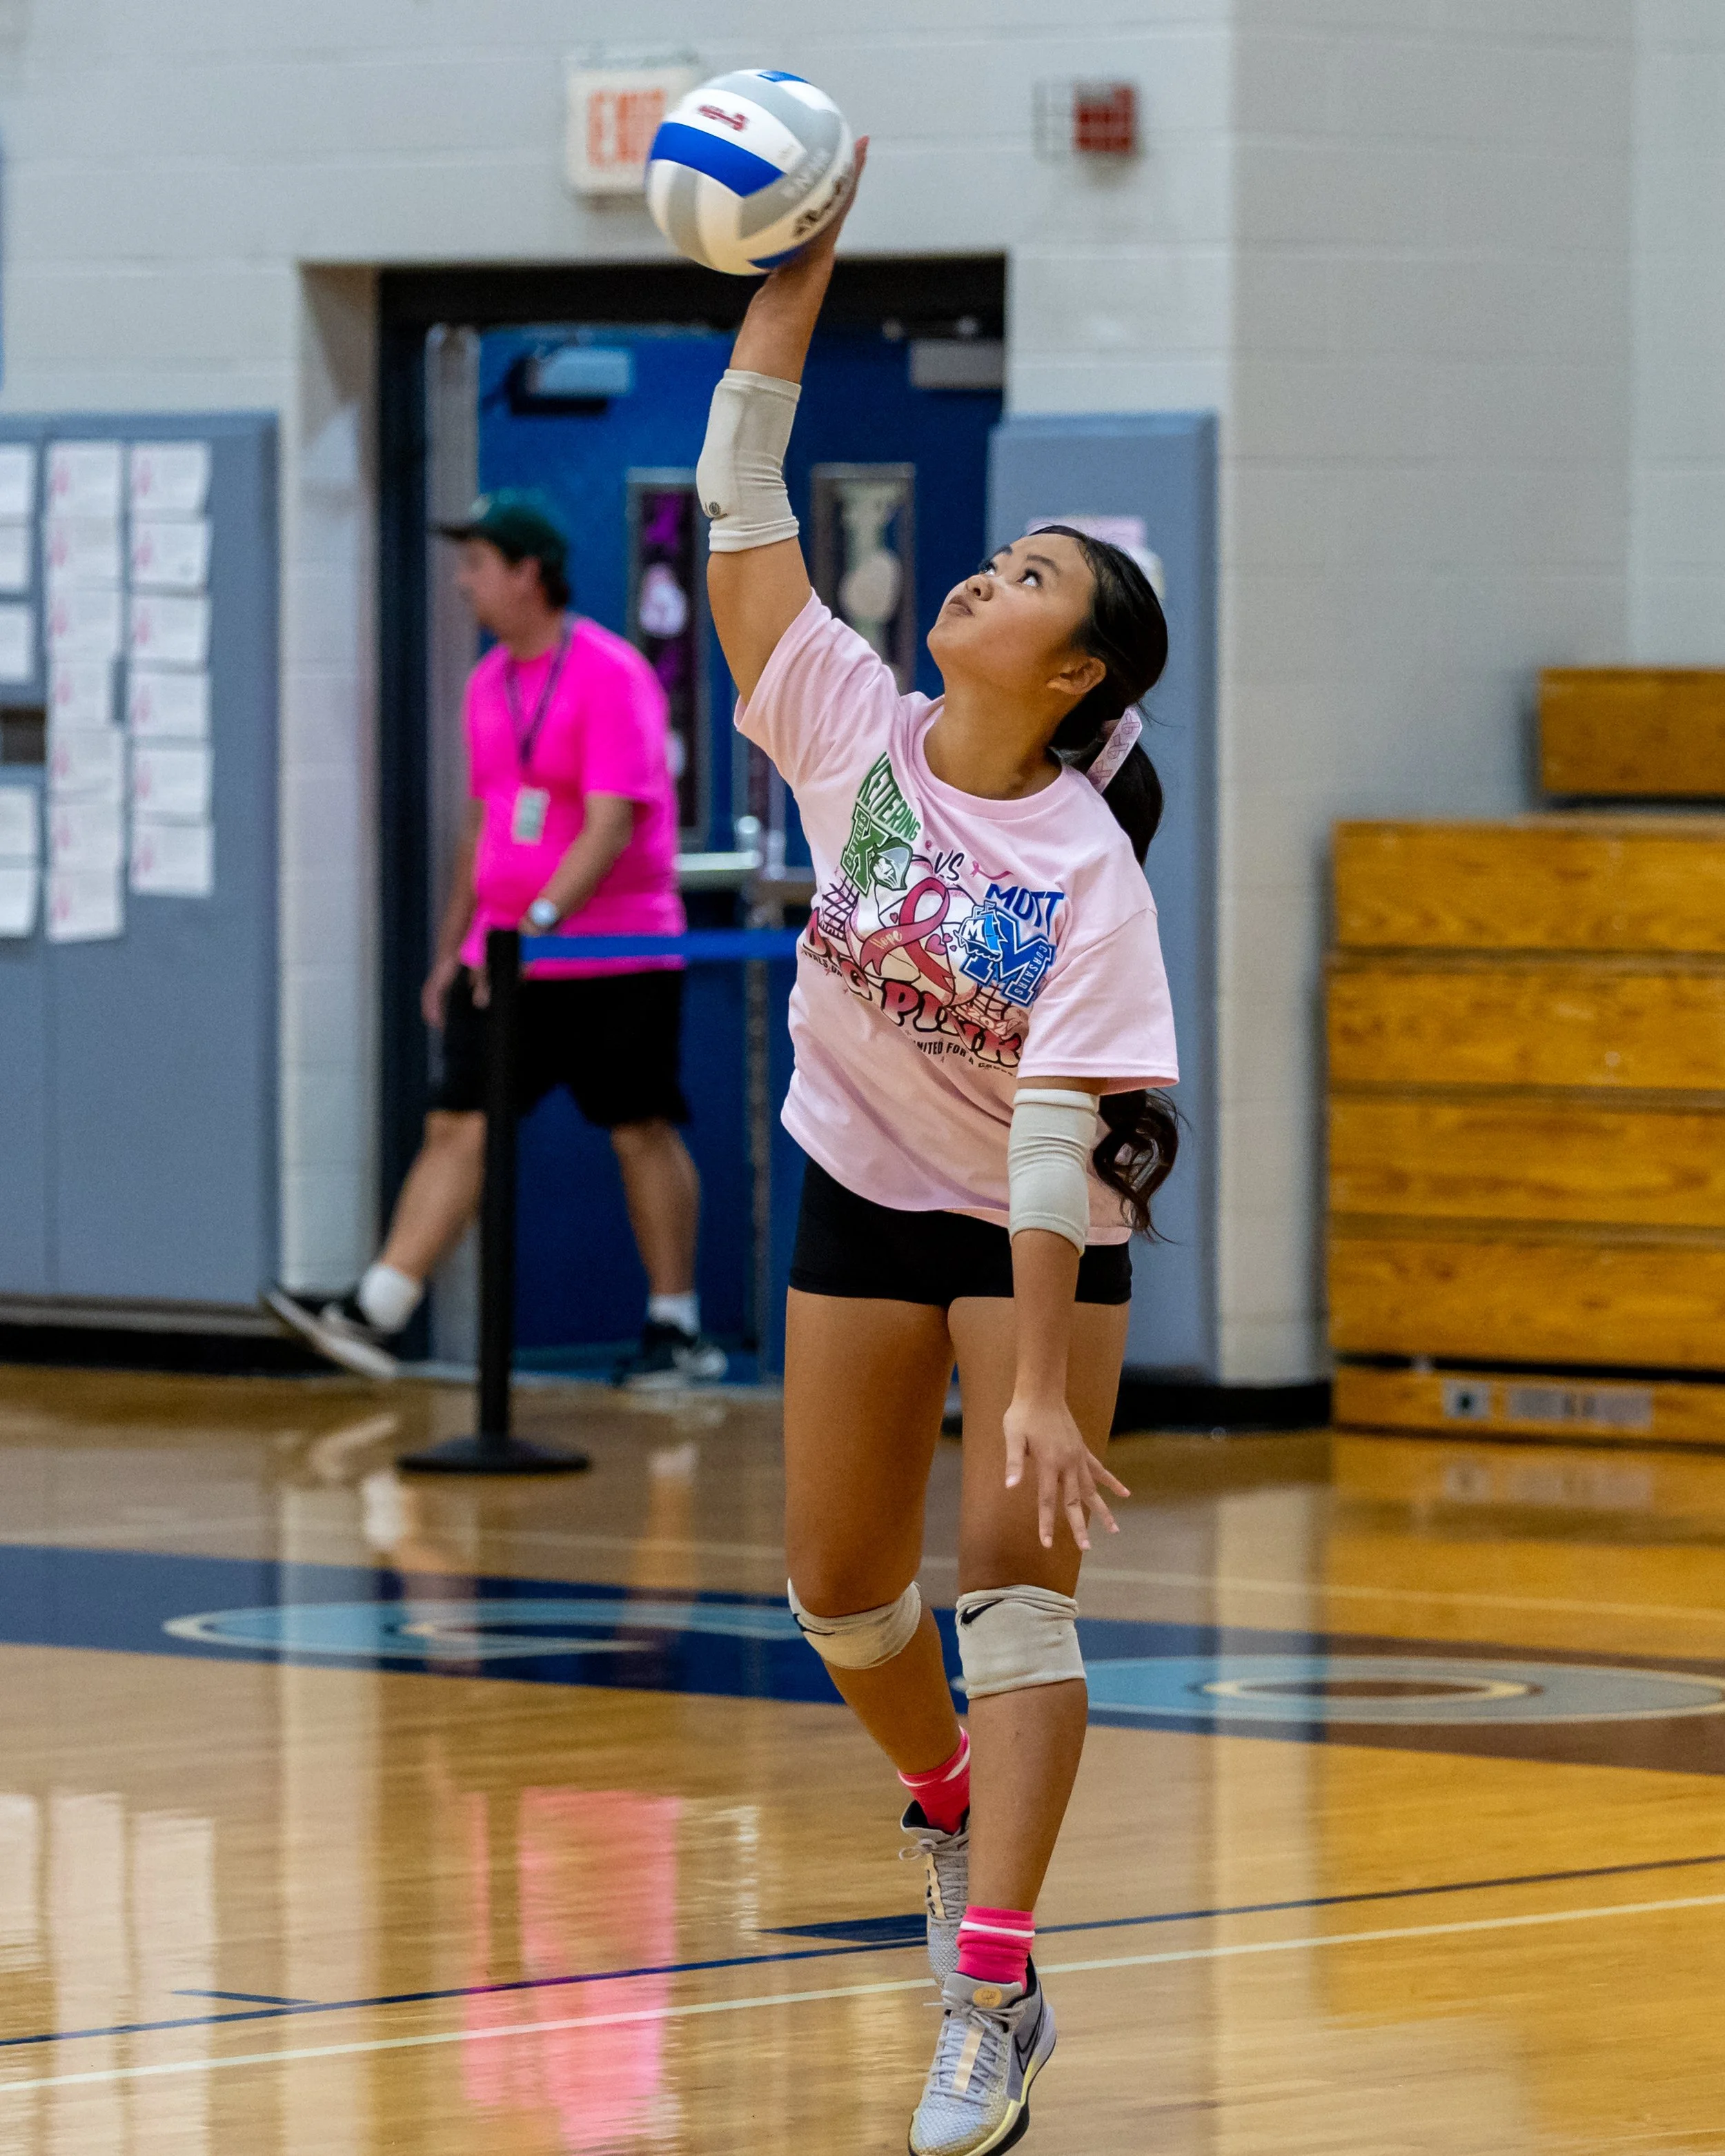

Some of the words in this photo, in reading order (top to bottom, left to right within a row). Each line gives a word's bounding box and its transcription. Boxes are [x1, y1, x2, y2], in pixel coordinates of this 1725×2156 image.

[857, 751, 921, 841] KETTERING
[847, 815, 867, 866] CAPTAINS
[934, 849, 965, 881] VS
[985, 883, 1065, 937] MOTT
[1014, 945, 1048, 996] CORSAIRS
[914, 1040, 943, 1055] NITED
[946, 1042, 967, 1057] FOR
